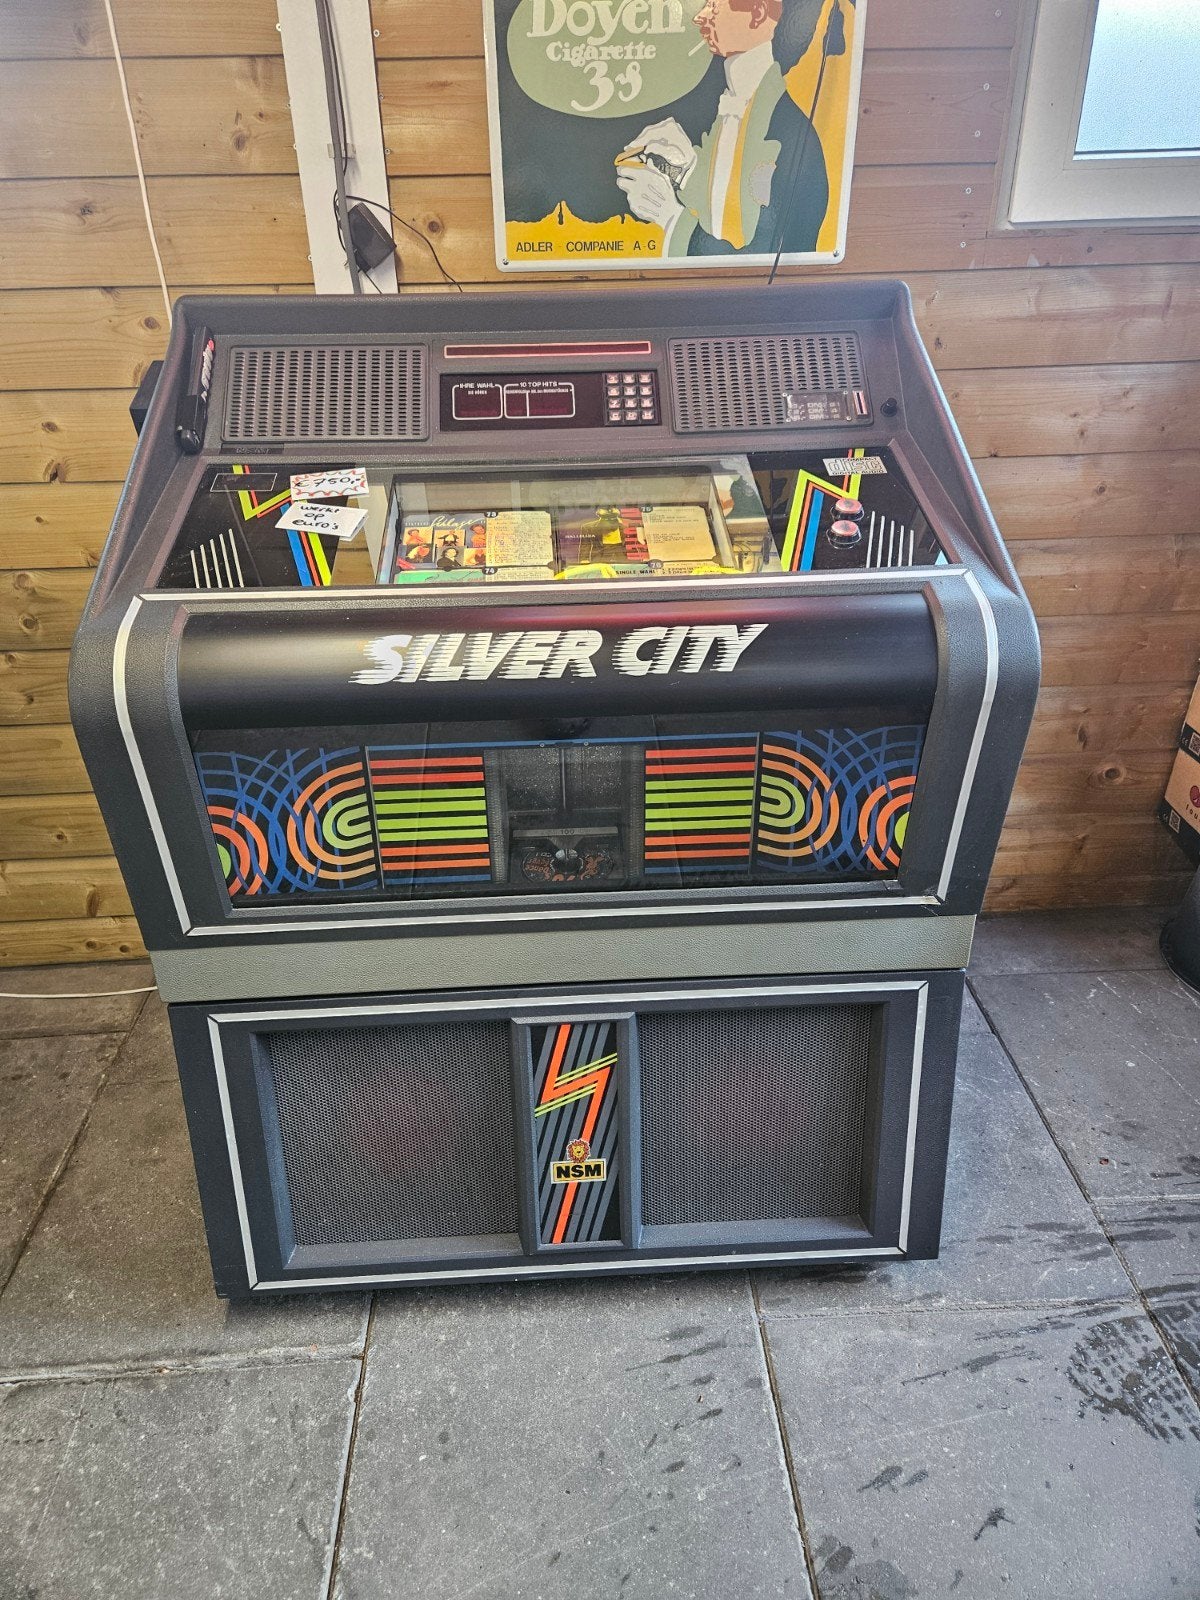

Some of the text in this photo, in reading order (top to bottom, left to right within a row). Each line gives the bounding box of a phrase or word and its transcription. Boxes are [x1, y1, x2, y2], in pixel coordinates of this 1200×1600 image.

[526, 0, 686, 46] Doyen
[546, 41, 657, 67] Cigarette
[516, 241, 553, 252] ADLER
[566, 240, 624, 252] COMPANIE
[304, 513, 325, 521] op
[348, 623, 770, 685] SILVER CITY
[556, 1163, 602, 1179] NSM
